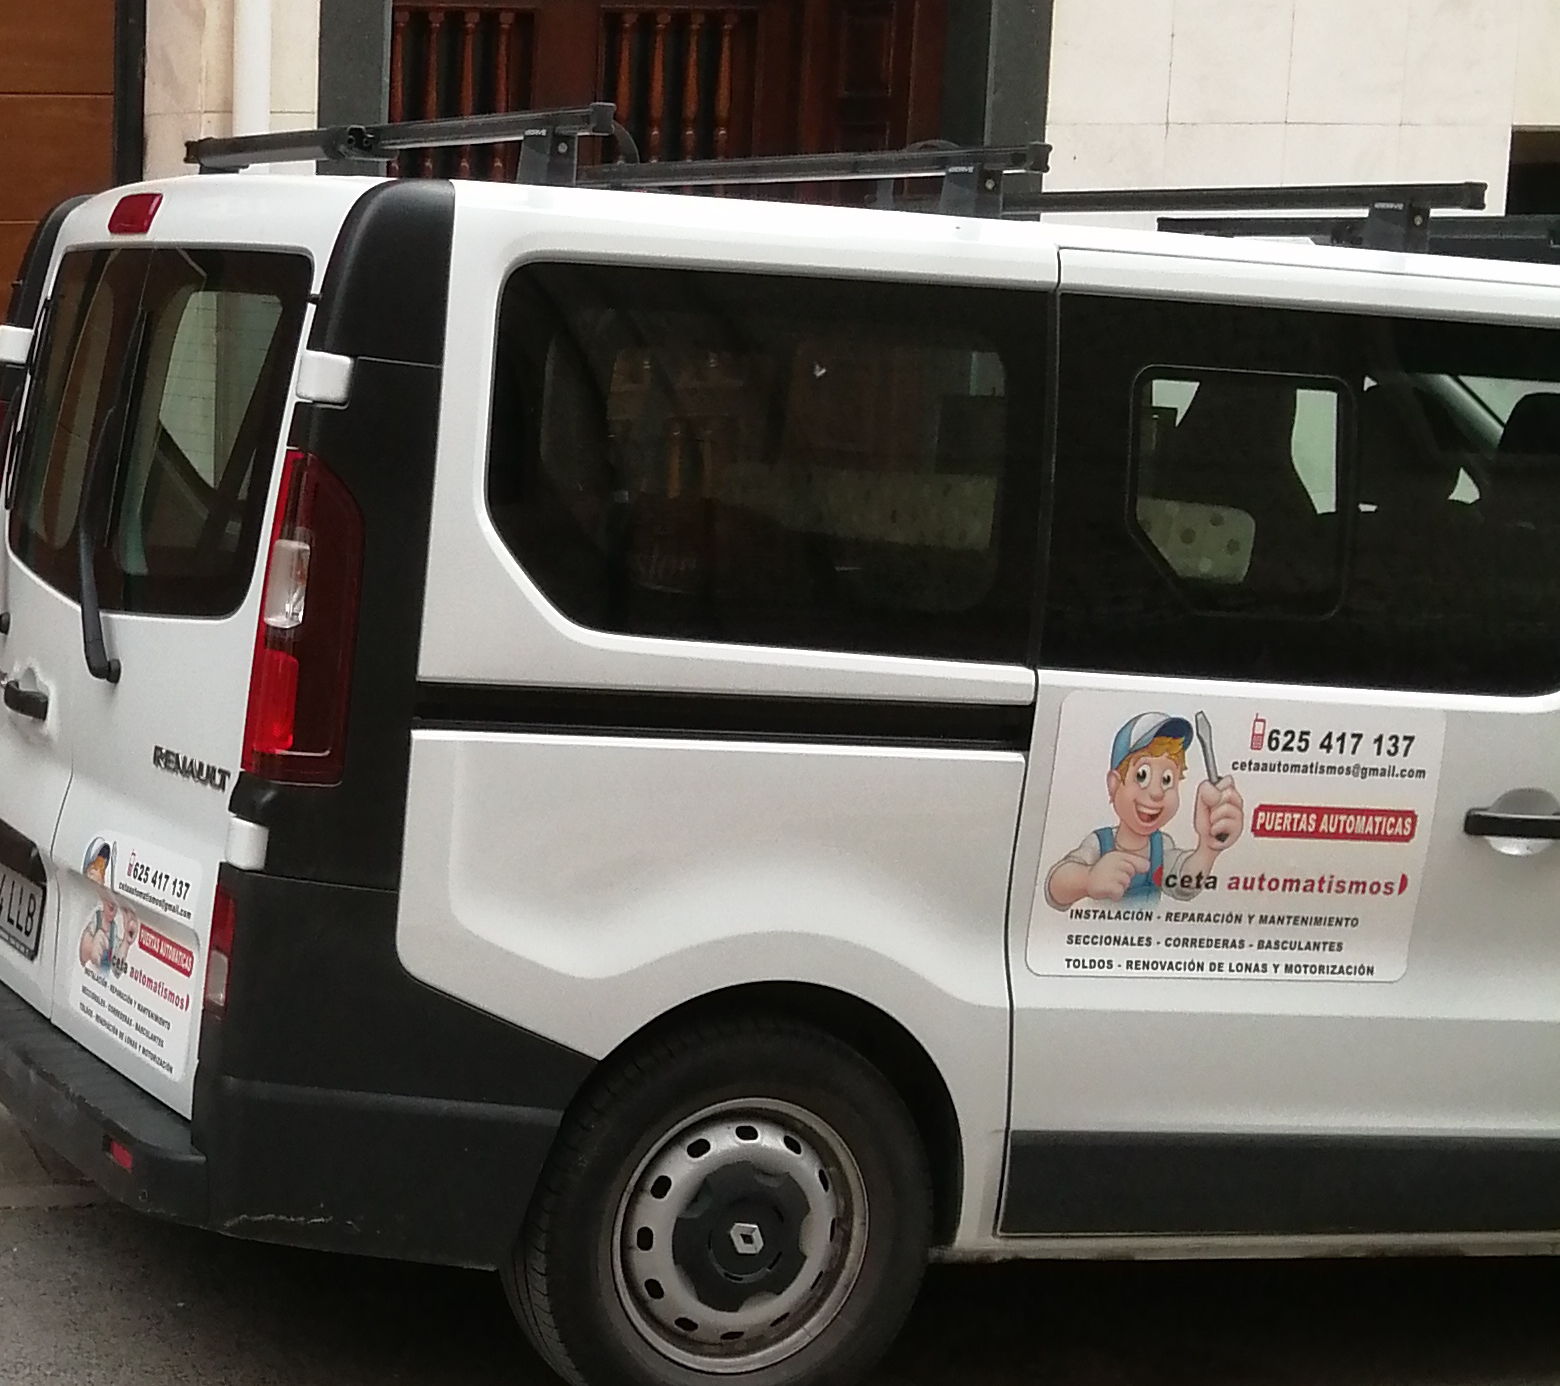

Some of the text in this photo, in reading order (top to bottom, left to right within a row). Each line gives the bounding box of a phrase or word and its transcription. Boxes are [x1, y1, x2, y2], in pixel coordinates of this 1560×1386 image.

[1268, 729, 1416, 757] 625 417 137
[153, 745, 231, 792] RENAULT
[1232, 760, 1426, 779] cetaautomatismos@gmail.com
[1256, 811, 1412, 835] PUERTAS AUTOMATICAS
[133, 862, 190, 900] 625 417 137
[1165, 871, 1395, 896] ceta automatismos
[1070, 909, 1152, 921] INSTALACIÓN
[1165, 911, 1242, 925] REPARACIÓN
[1247, 913, 1256, 925] Y
[1258, 914, 1359, 928] MANTENIMIENTO
[1066, 935, 1152, 947] SECCIONALES
[1164, 937, 1245, 951] CORREDERAS
[1257, 940, 1344, 952] BASCULANTES
[1065, 958, 1114, 969] TOLDOS
[1126, 958, 1204, 972] RENOVACIÓN
[1209, 961, 1224, 973] DE
[1228, 962, 1268, 974] LONAS
[1272, 963, 1281, 975] Y
[1284, 962, 1375, 976] MOTORIZACIÓN
[130, 967, 184, 1011] automatismos
